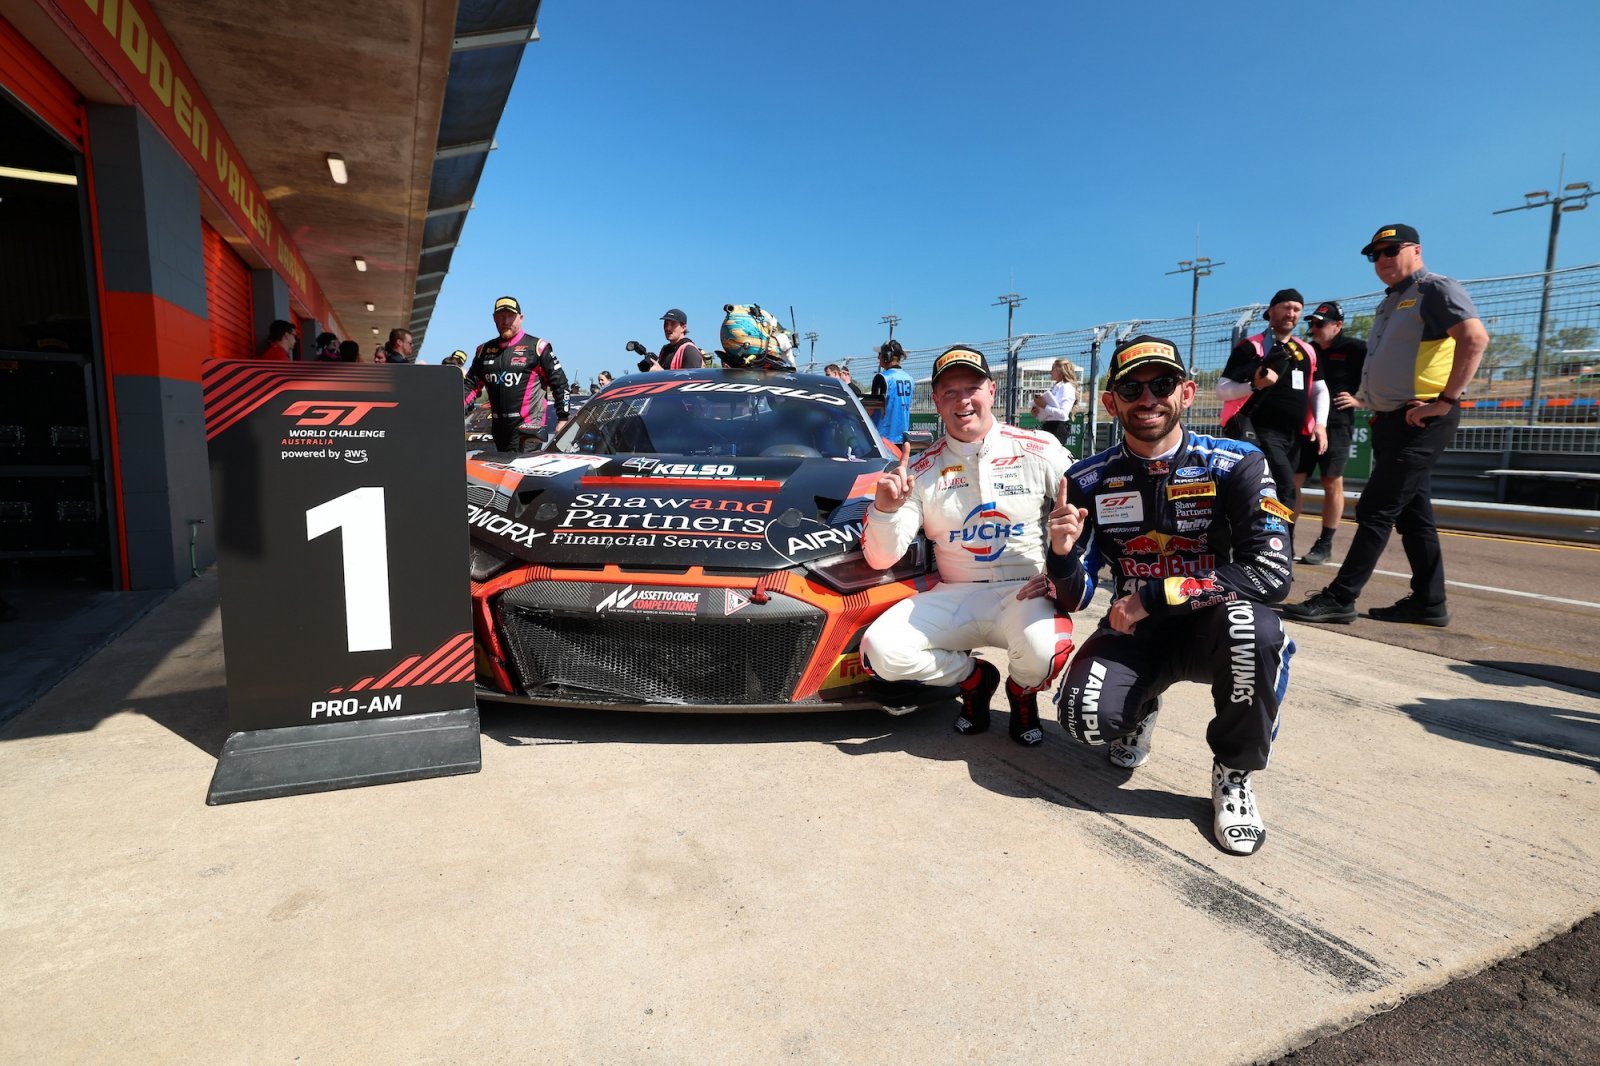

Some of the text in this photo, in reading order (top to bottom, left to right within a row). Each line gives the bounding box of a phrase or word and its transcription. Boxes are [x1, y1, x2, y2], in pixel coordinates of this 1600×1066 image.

[215, 136, 273, 247] VALLEY
[1120, 344, 1172, 364] PIRELLI
[678, 382, 847, 406] WORLD
[896, 379, 912, 397] 03
[281, 400, 400, 426] GT
[289, 429, 386, 438] WORLD CHALLENGE
[281, 438, 334, 446] AUSTRALIA
[281, 449, 368, 464] powered by aws
[1213, 457, 1235, 470] OMP
[652, 463, 736, 476] KELSO
[1079, 471, 1099, 486] OMP
[1171, 485, 1211, 497] PIRELLI
[1100, 495, 1138, 507] GT
[1175, 501, 1197, 509] Shaw
[1176, 508, 1213, 517] Partners
[557, 509, 766, 534] Partners
[949, 522, 1024, 543] FUCHS
[549, 532, 763, 552] Financial Services
[305, 486, 392, 652] 1
[1119, 554, 1216, 578] Red Bull
[636, 591, 700, 603] ASSETTO CORSA
[632, 600, 698, 612] COMPETIZIONE
[1230, 643, 1255, 706] WINGS
[310, 694, 402, 719] PRO-AM
[1228, 827, 1260, 839] OMP
